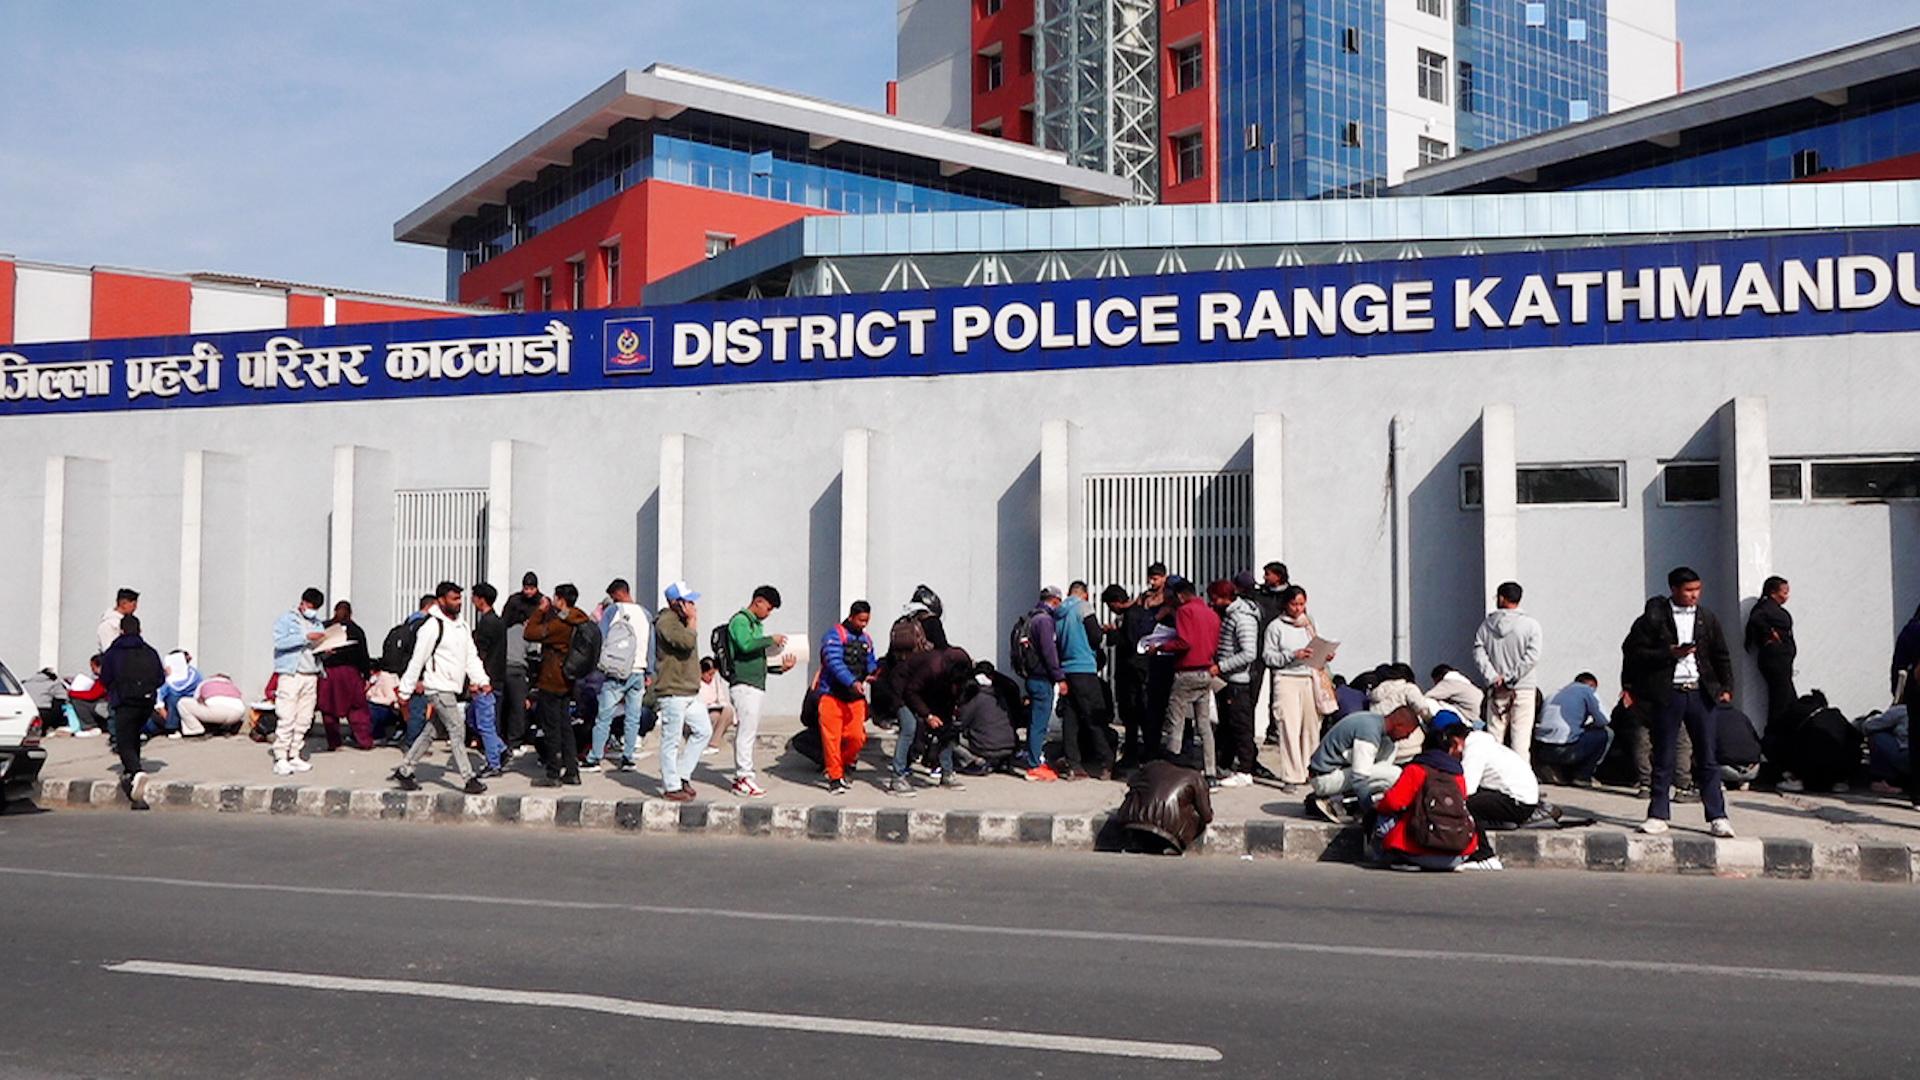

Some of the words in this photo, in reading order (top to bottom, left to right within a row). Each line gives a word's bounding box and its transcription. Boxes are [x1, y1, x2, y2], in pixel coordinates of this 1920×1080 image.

[673, 309, 936, 366] DISTRICT
[953, 296, 1180, 353] POLICE
[1199, 281, 1435, 341] RANGE
[0, 352, 113, 400] जिल्ला
[125, 341, 223, 398] प्रहरी
[236, 336, 372, 388] परिसर
